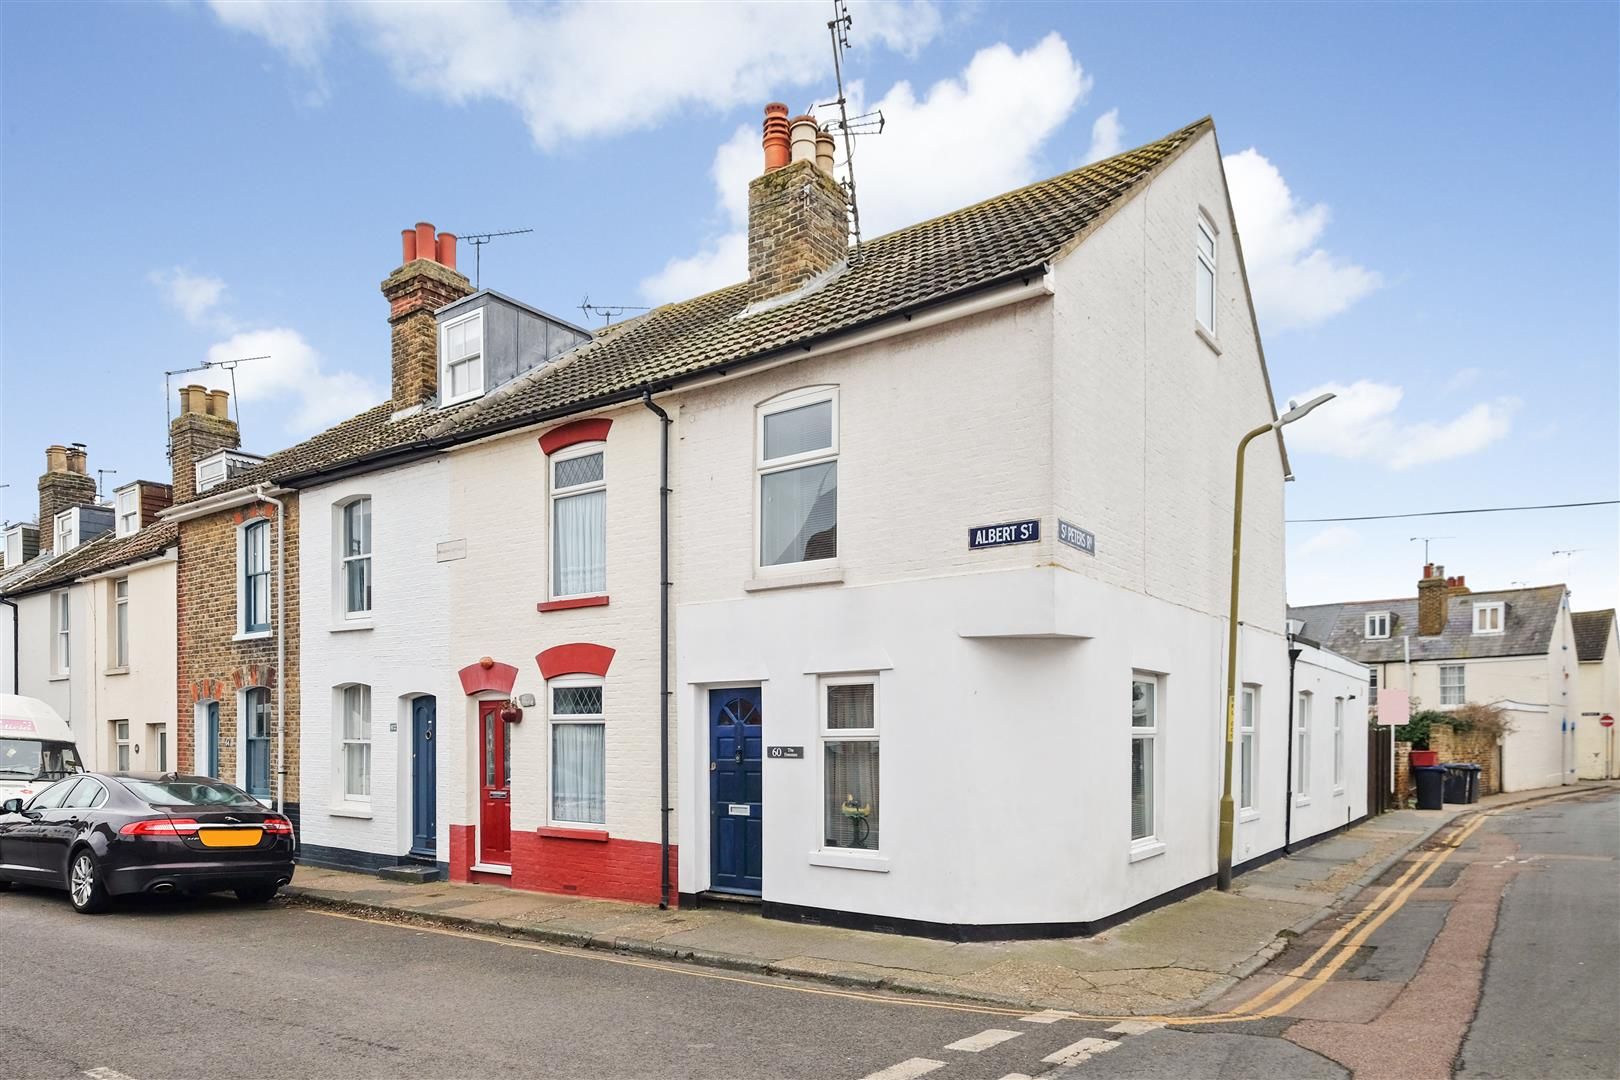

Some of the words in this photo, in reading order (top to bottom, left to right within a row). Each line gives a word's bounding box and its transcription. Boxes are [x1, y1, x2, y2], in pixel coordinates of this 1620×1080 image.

[975, 526, 1017, 545] ALBERT
[1020, 523, 1033, 539] ST
[772, 747, 782, 757] 60
